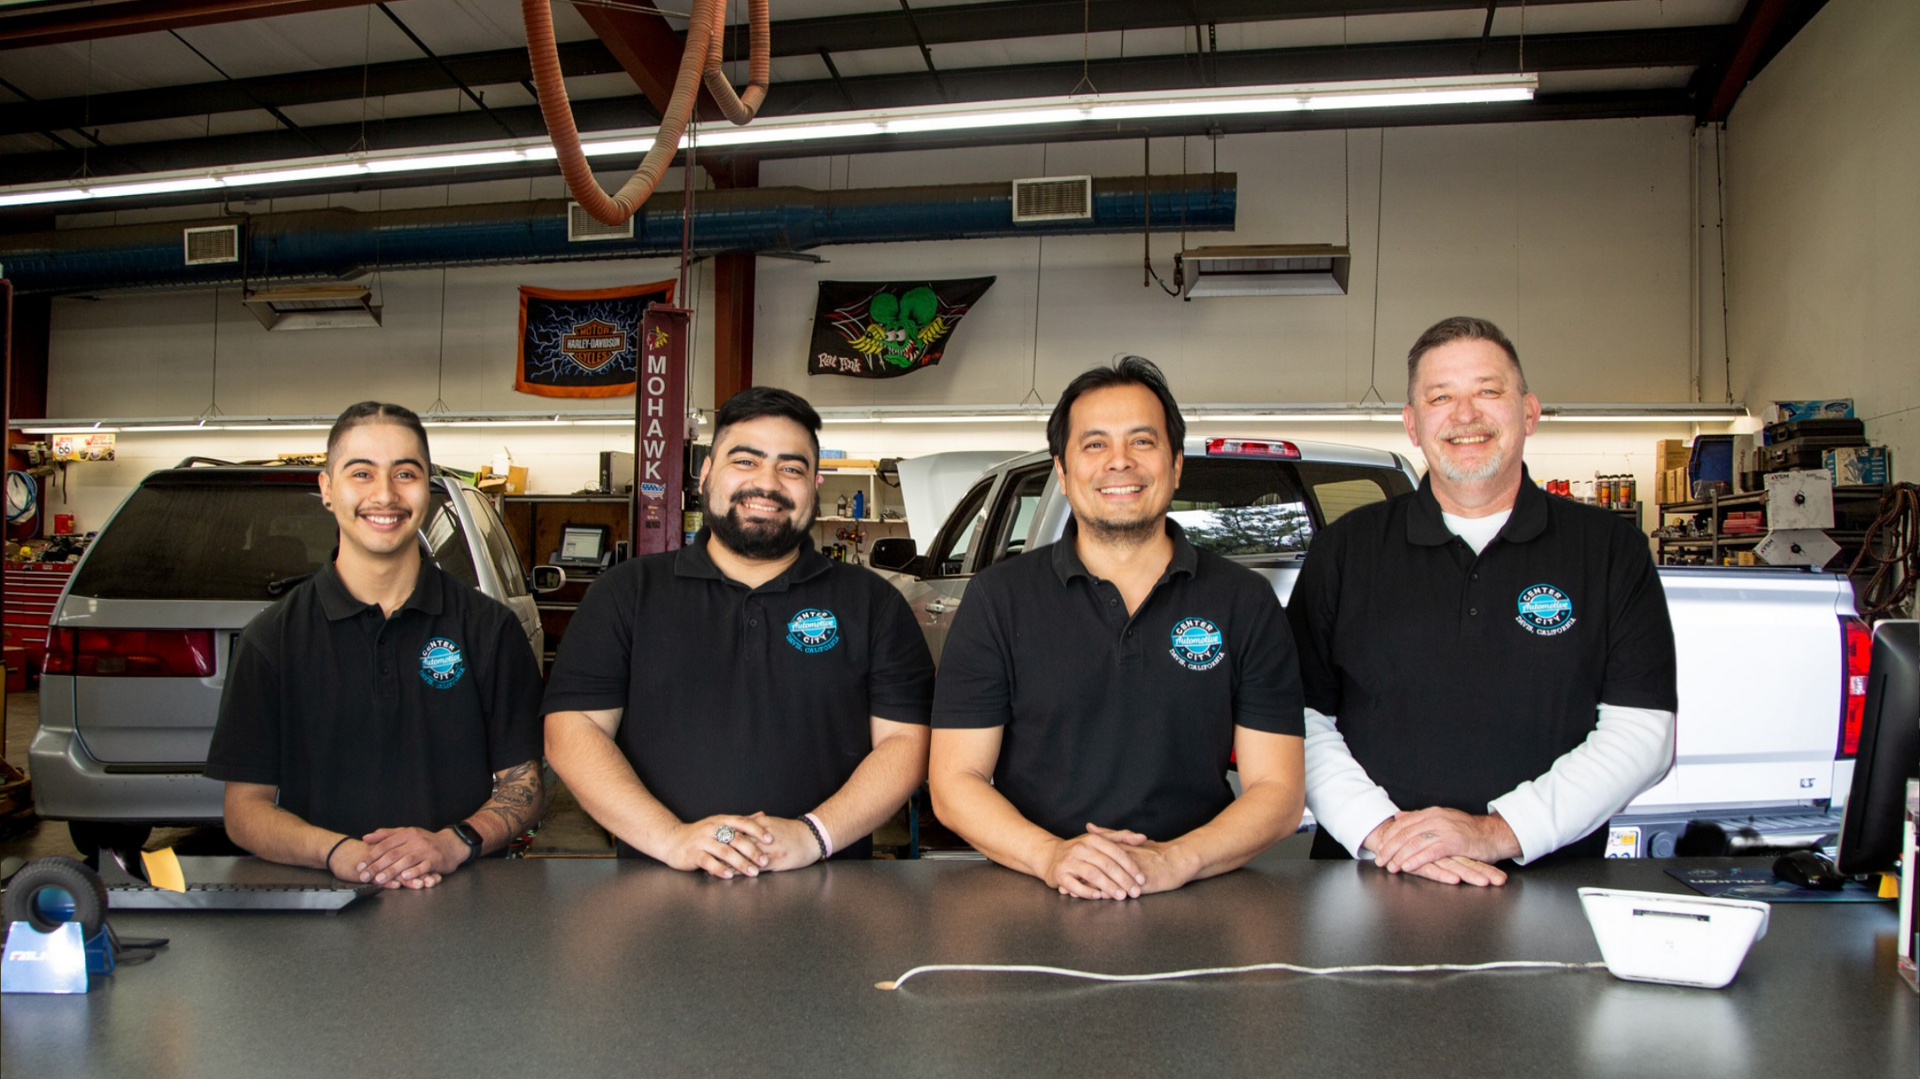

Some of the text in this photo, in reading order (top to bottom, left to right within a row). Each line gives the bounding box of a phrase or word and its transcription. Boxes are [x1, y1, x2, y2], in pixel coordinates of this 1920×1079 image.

[579, 324, 610, 336] MOTOR
[566, 337, 620, 349] HARLEY-DAVIDSON
[578, 351, 609, 365] CYCLES
[818, 352, 861, 373] Rat Fink
[643, 355, 666, 480] MOHAWK
[58, 443, 70, 454] 66
[1523, 587, 1562, 601] CENTER
[1522, 602, 1568, 612] Automotive
[793, 612, 828, 623] ENTER
[1535, 615, 1561, 626] CITY
[792, 620, 834, 630] Automotive
[1176, 619, 1213, 634] CENTER
[1536, 617, 1577, 636] CALIFORNIA
[803, 634, 827, 645] CITY
[1175, 634, 1219, 646] Automotive
[422, 639, 455, 656] CENTER
[1186, 650, 1211, 661] CITY
[1187, 651, 1225, 670] CALIFORNIA
[433, 669, 454, 680] CITY
